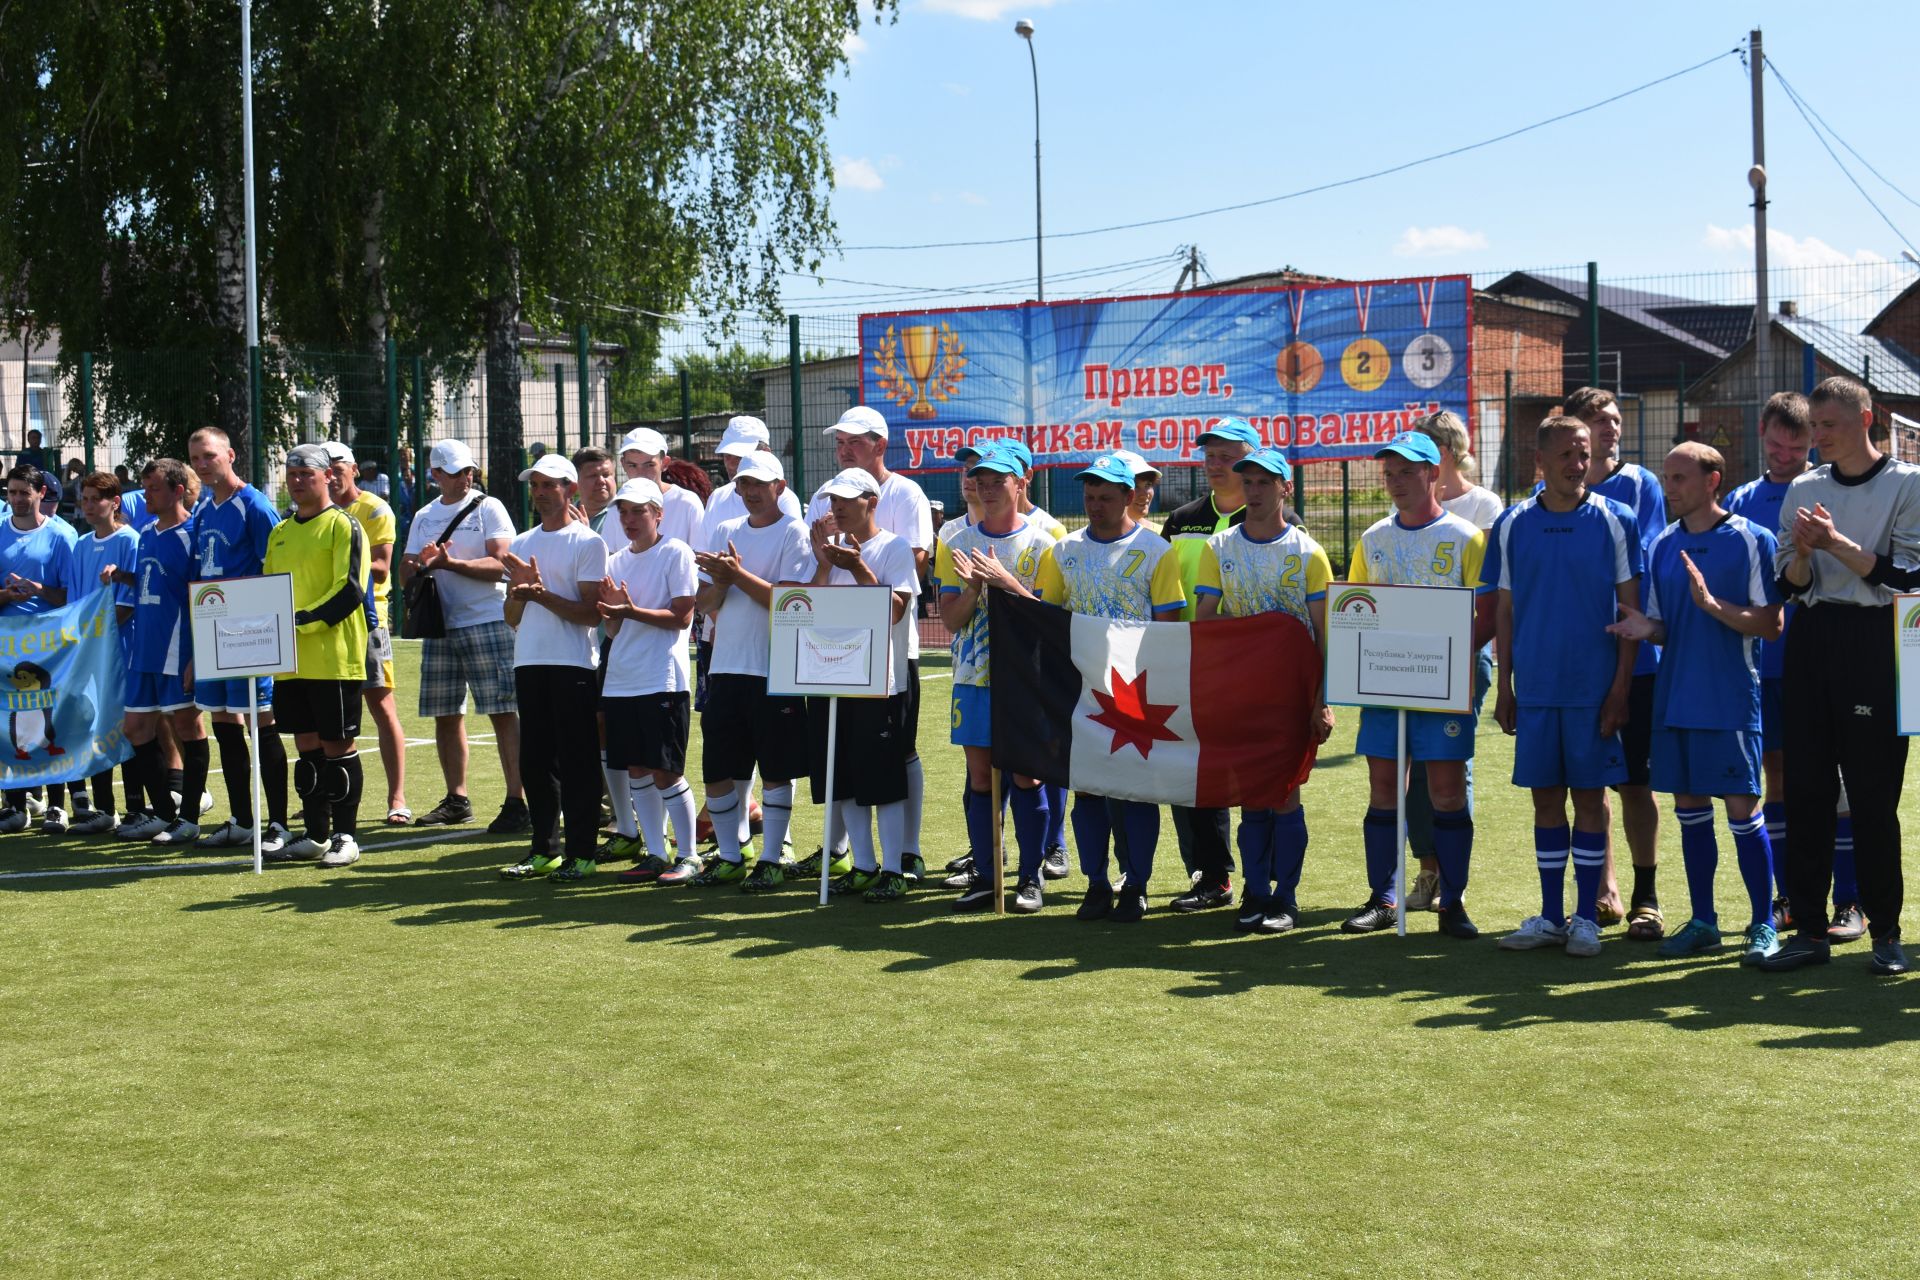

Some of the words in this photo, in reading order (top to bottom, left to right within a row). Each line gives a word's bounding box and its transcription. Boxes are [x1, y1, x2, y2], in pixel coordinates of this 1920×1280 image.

[1293, 353, 1300, 376] 1
[1356, 351, 1371, 375] 2
[1421, 347, 1436, 371] 3
[1084, 362, 1234, 407] Привет,
[1136, 401, 1441, 459] сорнований
[1016, 547, 1037, 577] 6
[1121, 550, 1147, 578] 7
[1280, 554, 1301, 588] 2
[1432, 542, 1455, 576] 5
[1363, 649, 1406, 661] Республика
[1407, 651, 1444, 661] Удмуртия
[1368, 662, 1415, 673] Глазовский
[1417, 664, 1438, 674] ПНИ
